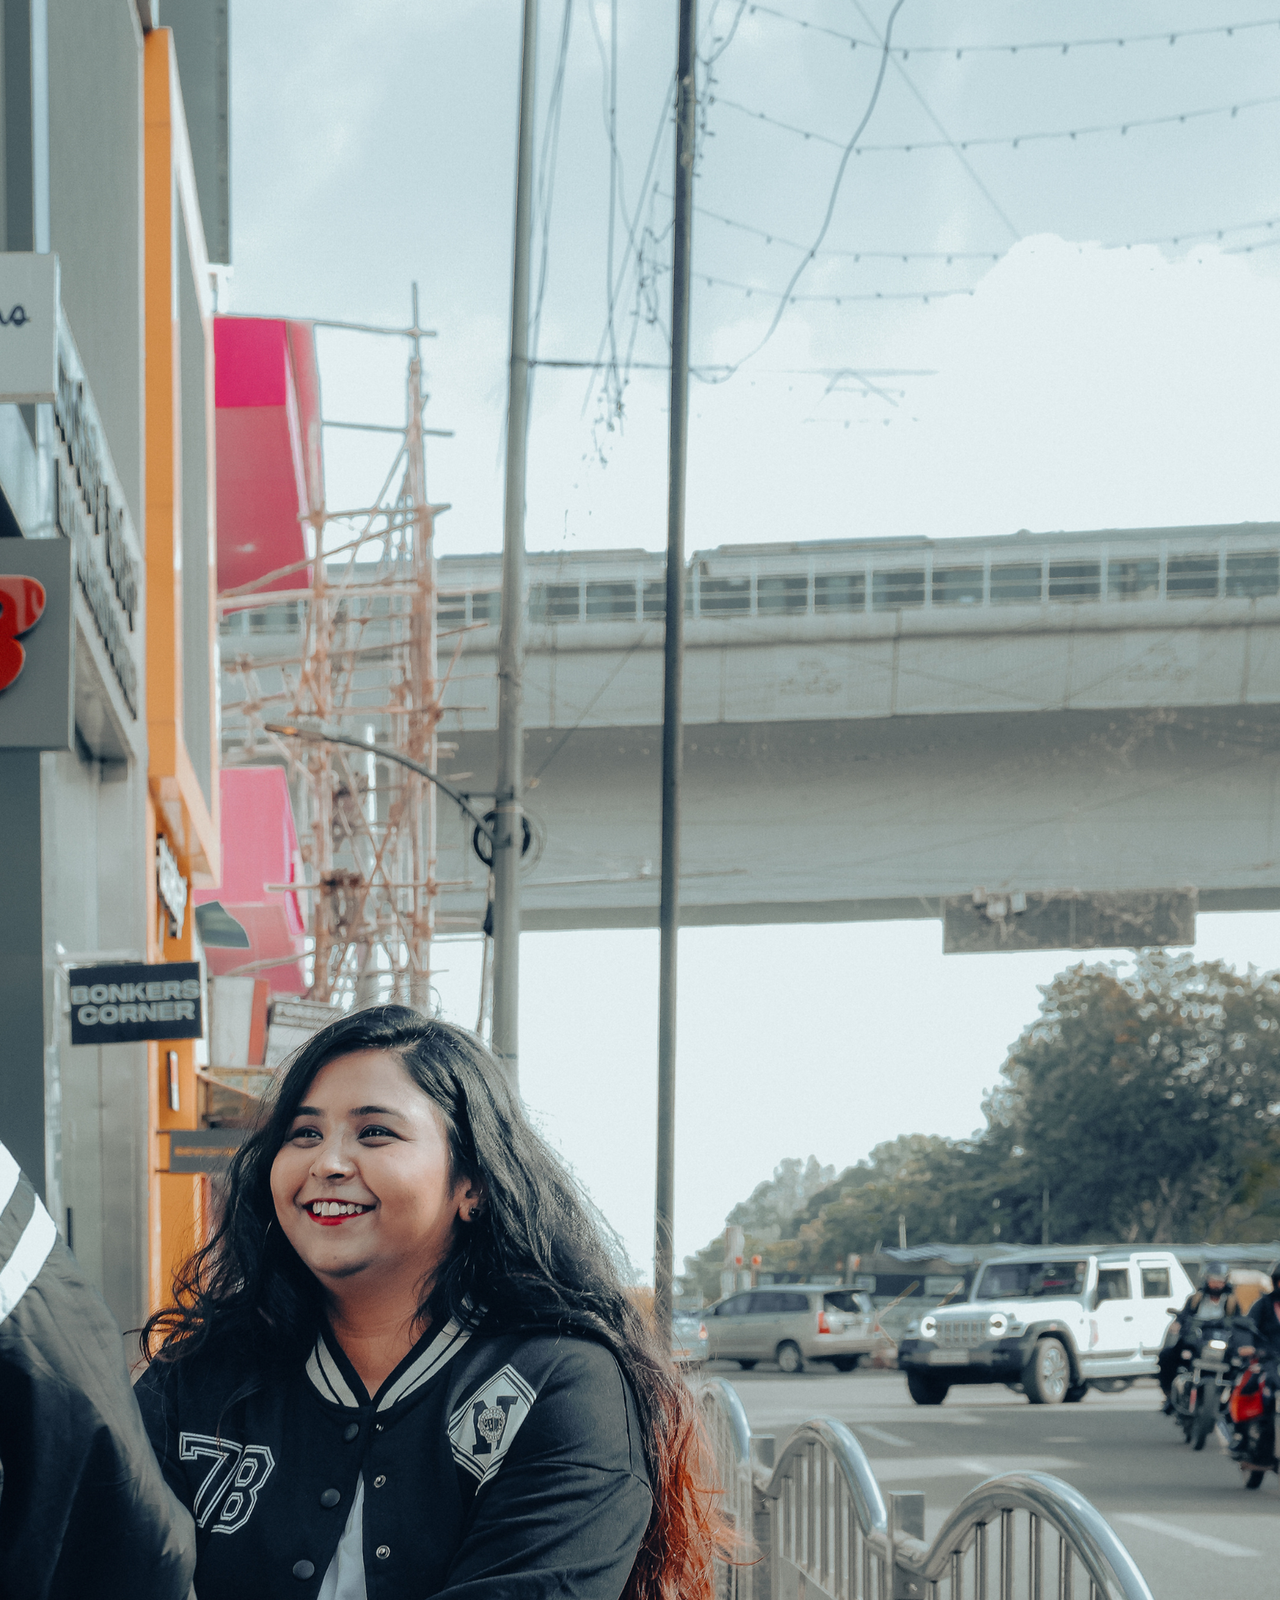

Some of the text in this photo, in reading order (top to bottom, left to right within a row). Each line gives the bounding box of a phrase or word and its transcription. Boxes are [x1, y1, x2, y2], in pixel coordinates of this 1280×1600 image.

[70, 978, 201, 1005] BONKERS
[77, 1000, 196, 1026] CORNER
[179, 1431, 276, 1535] 78
